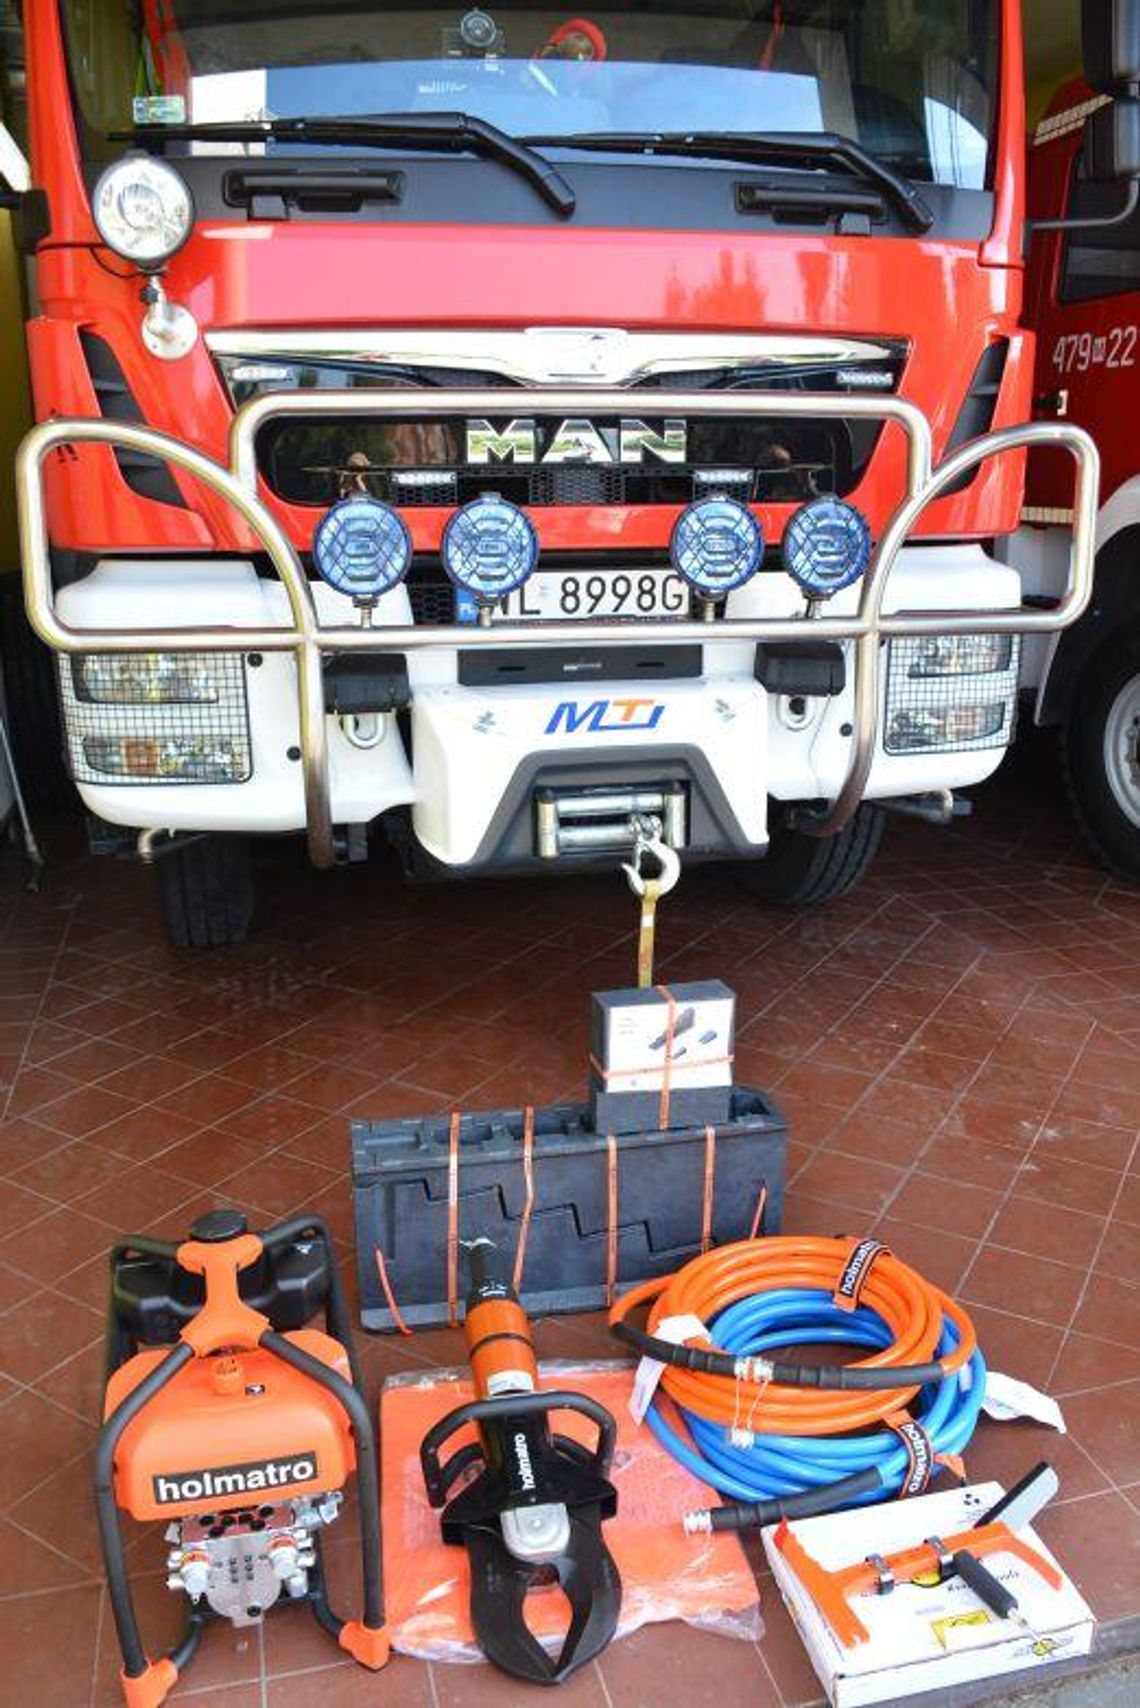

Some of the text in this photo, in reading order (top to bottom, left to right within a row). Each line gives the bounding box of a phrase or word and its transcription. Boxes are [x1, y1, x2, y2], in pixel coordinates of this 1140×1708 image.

[466, 418, 687, 463] MAN
[560, 574, 684, 614] 8998G
[157, 1460, 314, 1502] holmatro
[514, 1432, 537, 1491] holmatro
